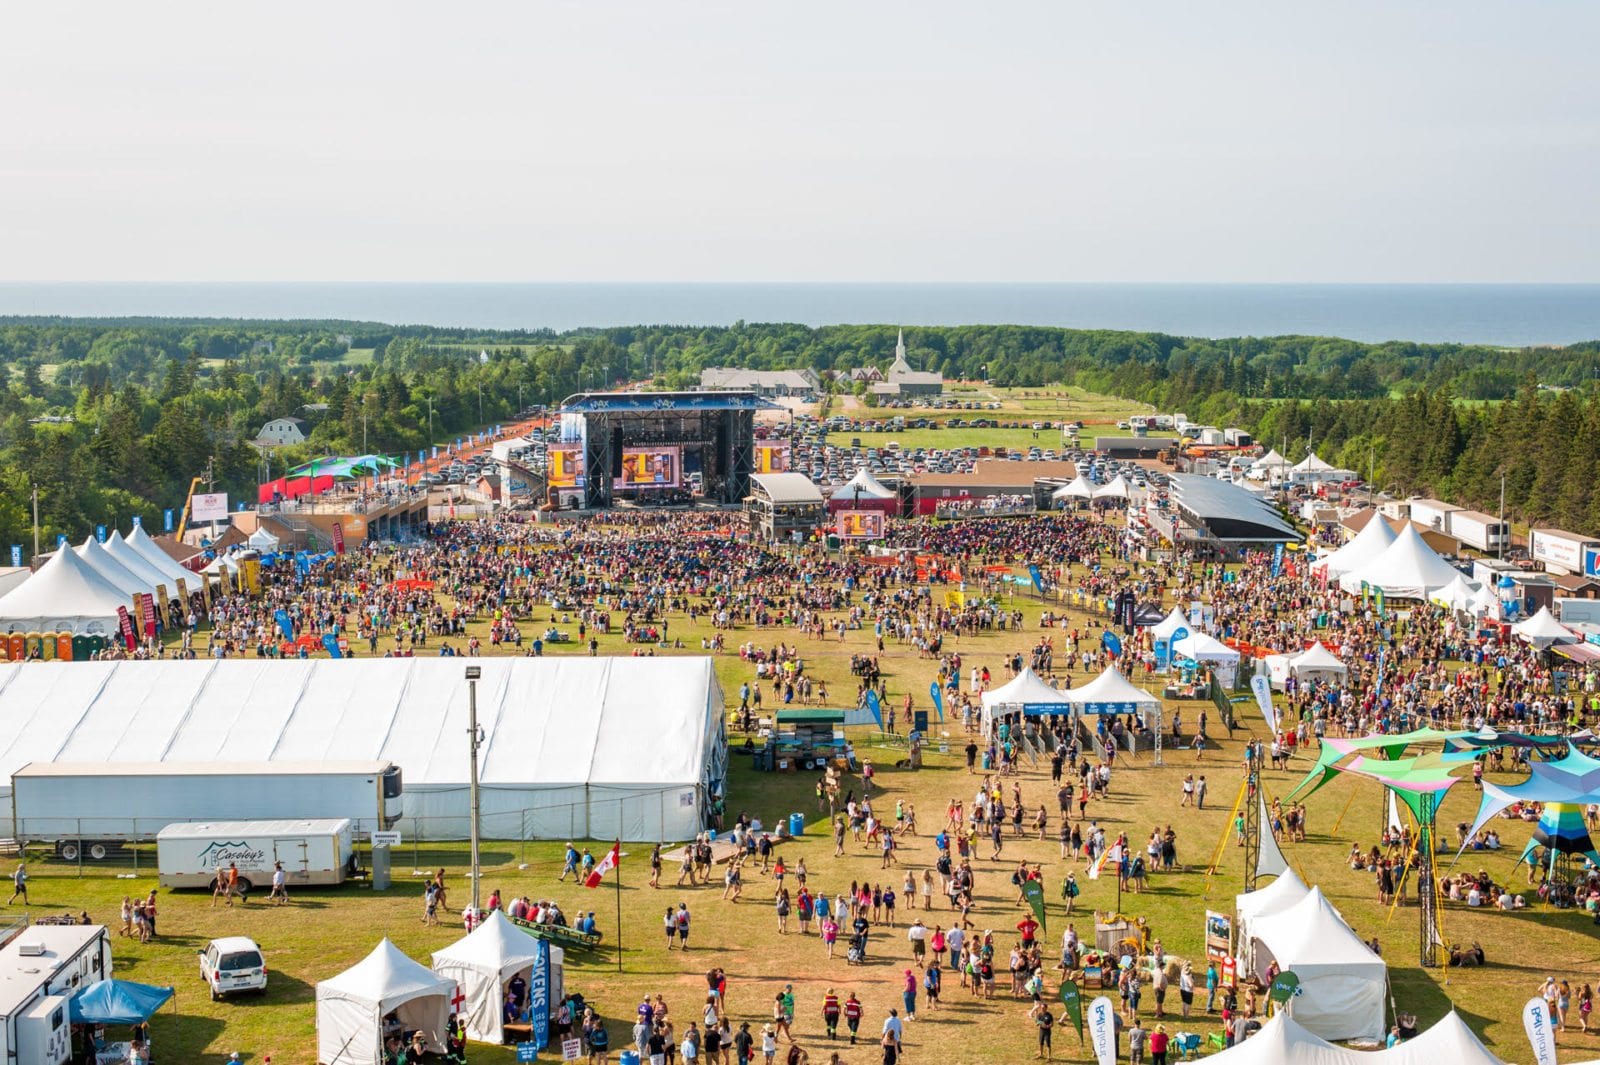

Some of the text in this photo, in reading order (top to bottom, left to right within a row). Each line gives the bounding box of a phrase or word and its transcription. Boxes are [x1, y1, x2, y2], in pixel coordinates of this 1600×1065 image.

[653, 399, 676, 409] MAX
[217, 848, 264, 862] Caseley's
[532, 946, 546, 1009] TOKENS
